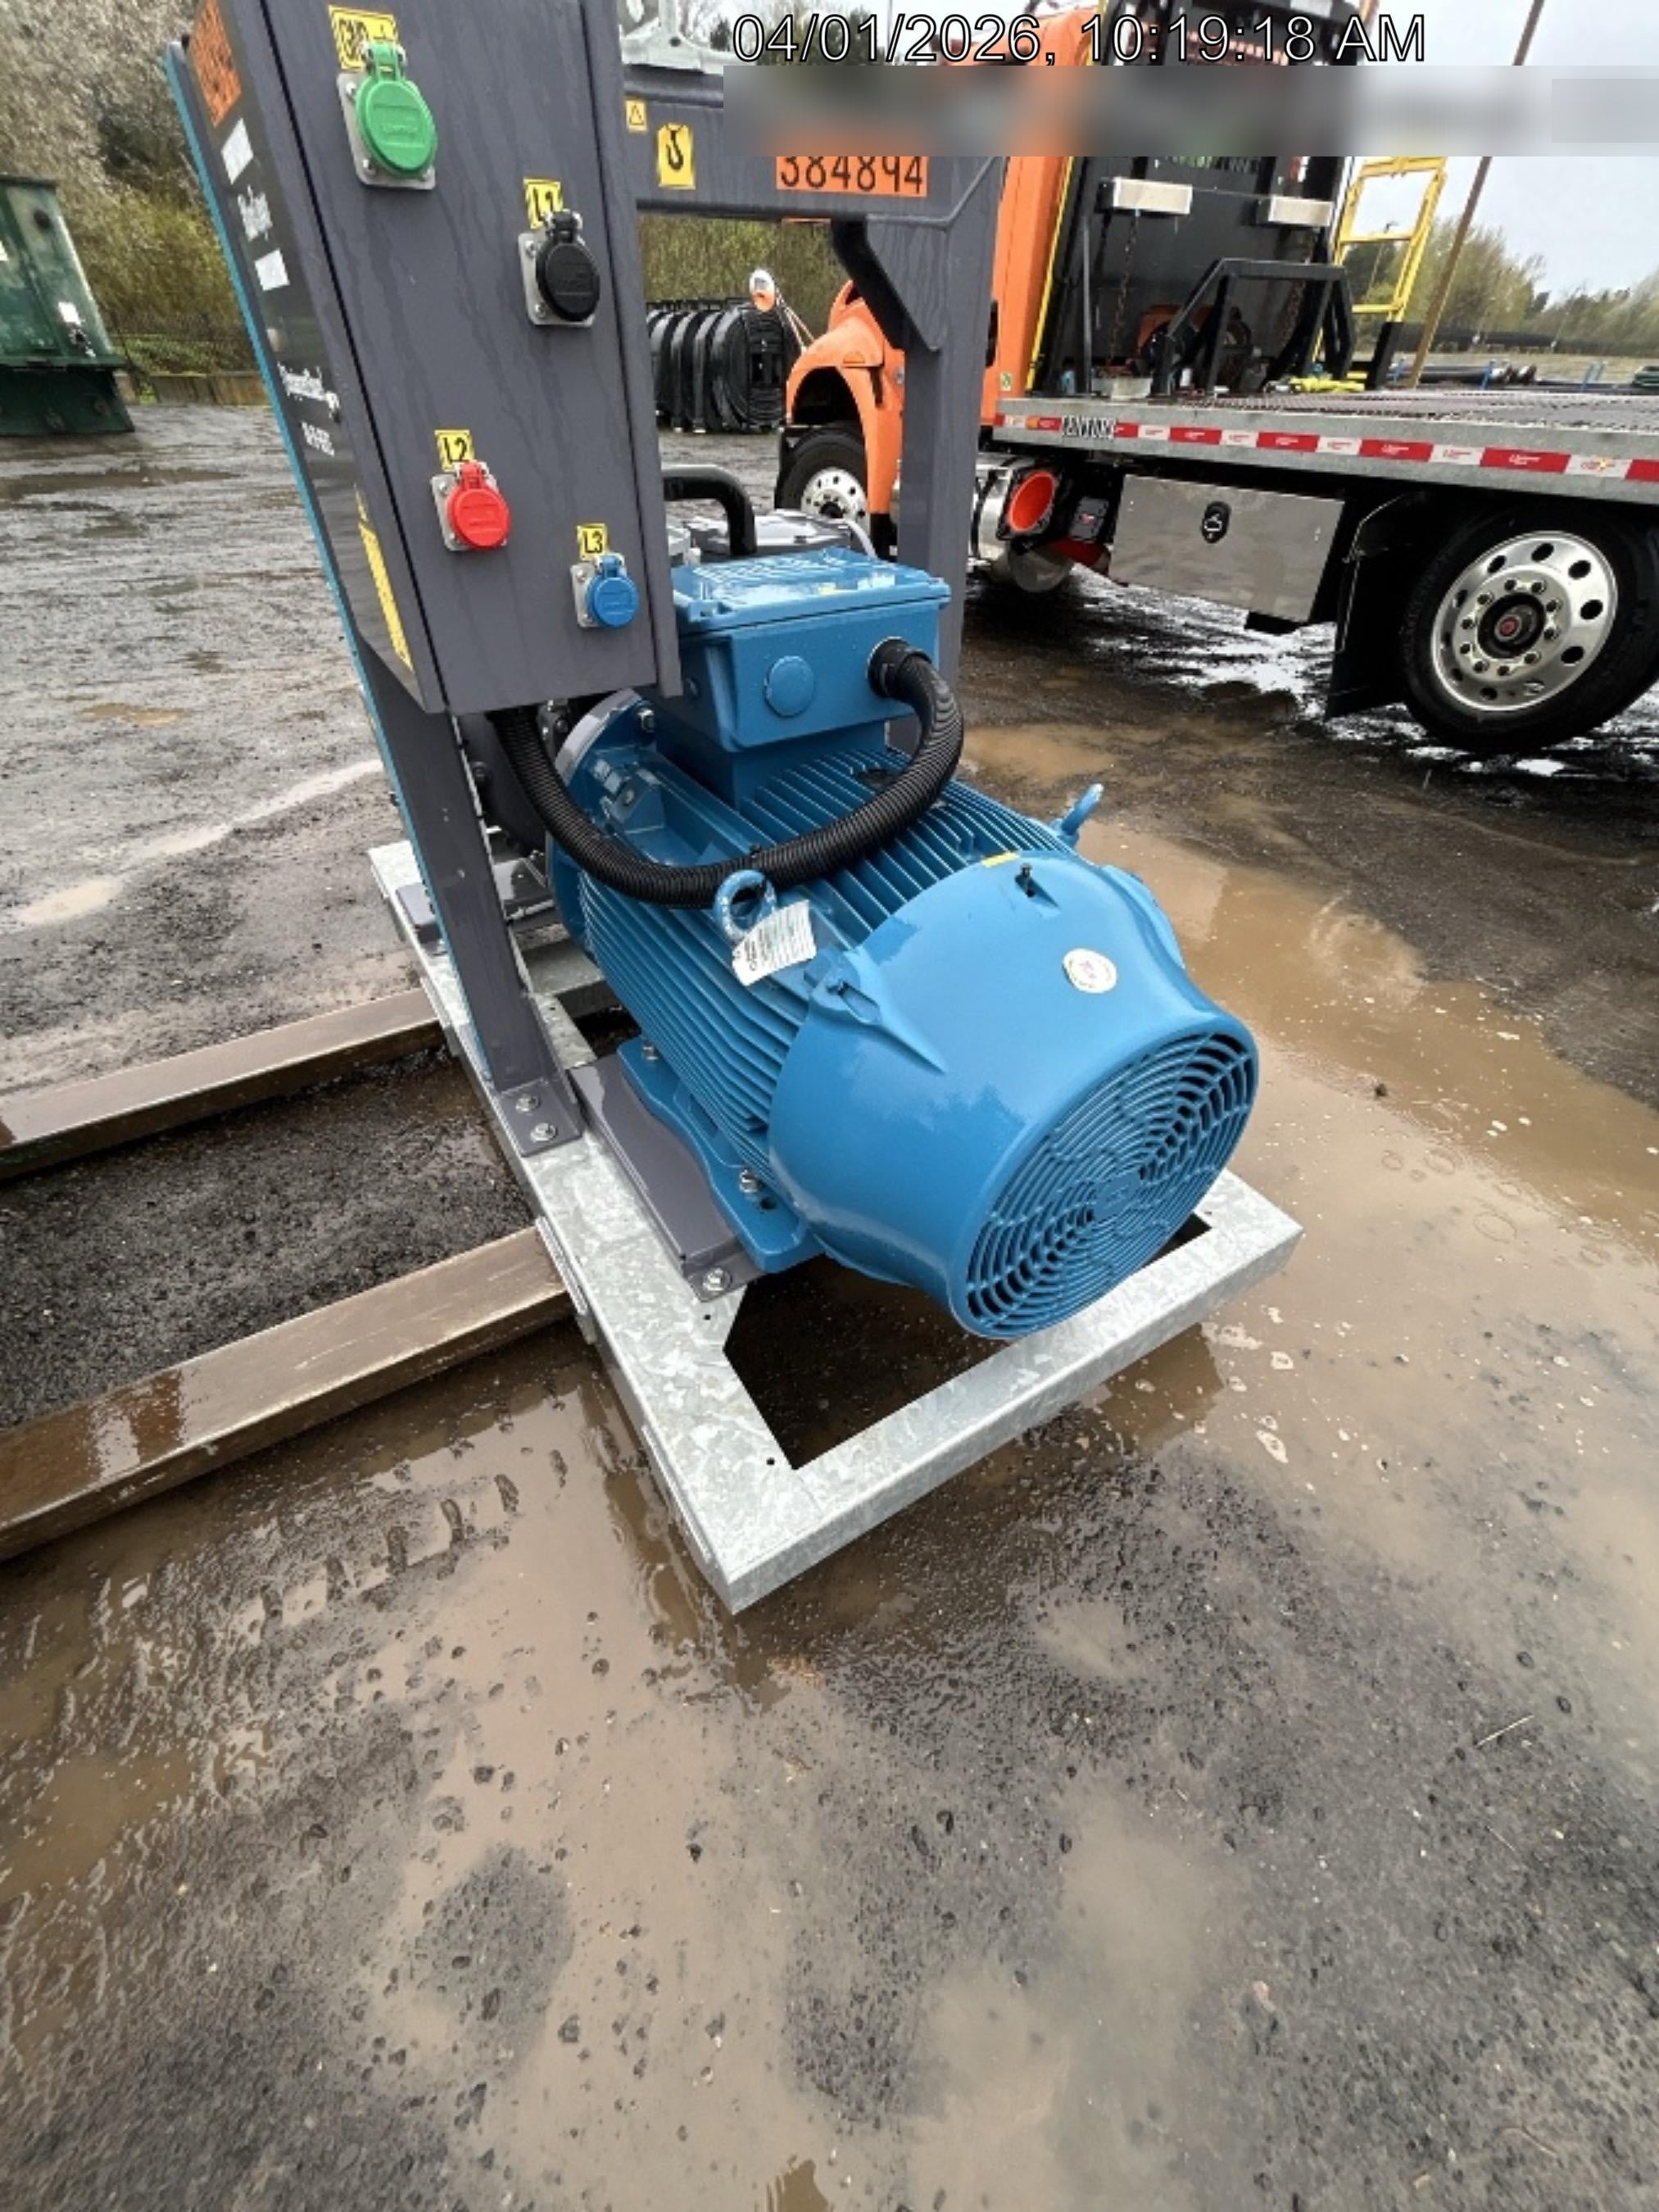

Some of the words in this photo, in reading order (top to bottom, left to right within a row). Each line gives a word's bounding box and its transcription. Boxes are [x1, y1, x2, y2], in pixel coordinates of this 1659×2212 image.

[781, 156, 922, 194] 384894
[442, 437, 469, 465] L2
[582, 530, 603, 554] L3
